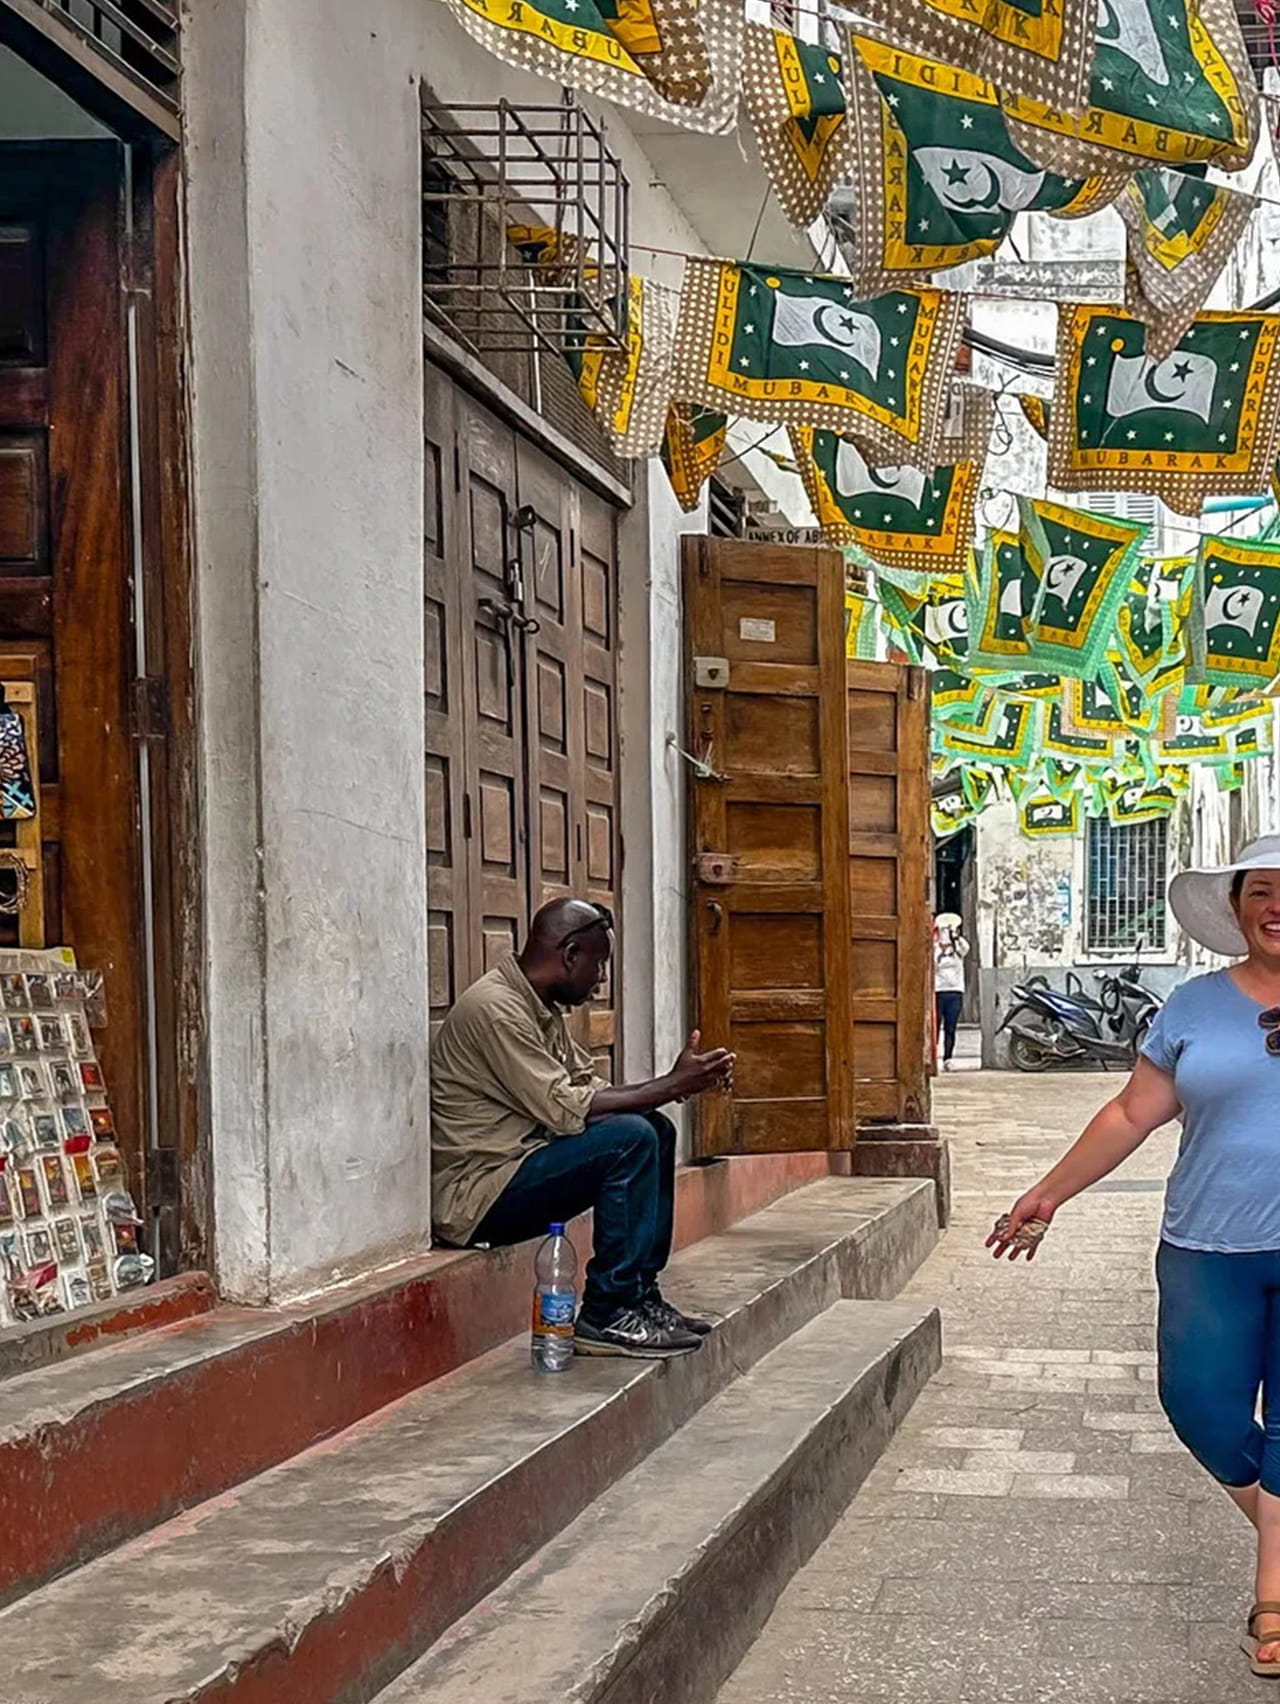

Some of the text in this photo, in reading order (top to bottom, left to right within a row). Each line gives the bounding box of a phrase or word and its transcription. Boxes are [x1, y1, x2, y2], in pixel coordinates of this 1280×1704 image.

[733, 377, 903, 428] MUBARAK
[1240, 324, 1278, 450] MUBARAK
[1079, 451, 1228, 469] MUBARAK
[786, 529, 801, 544] OF
